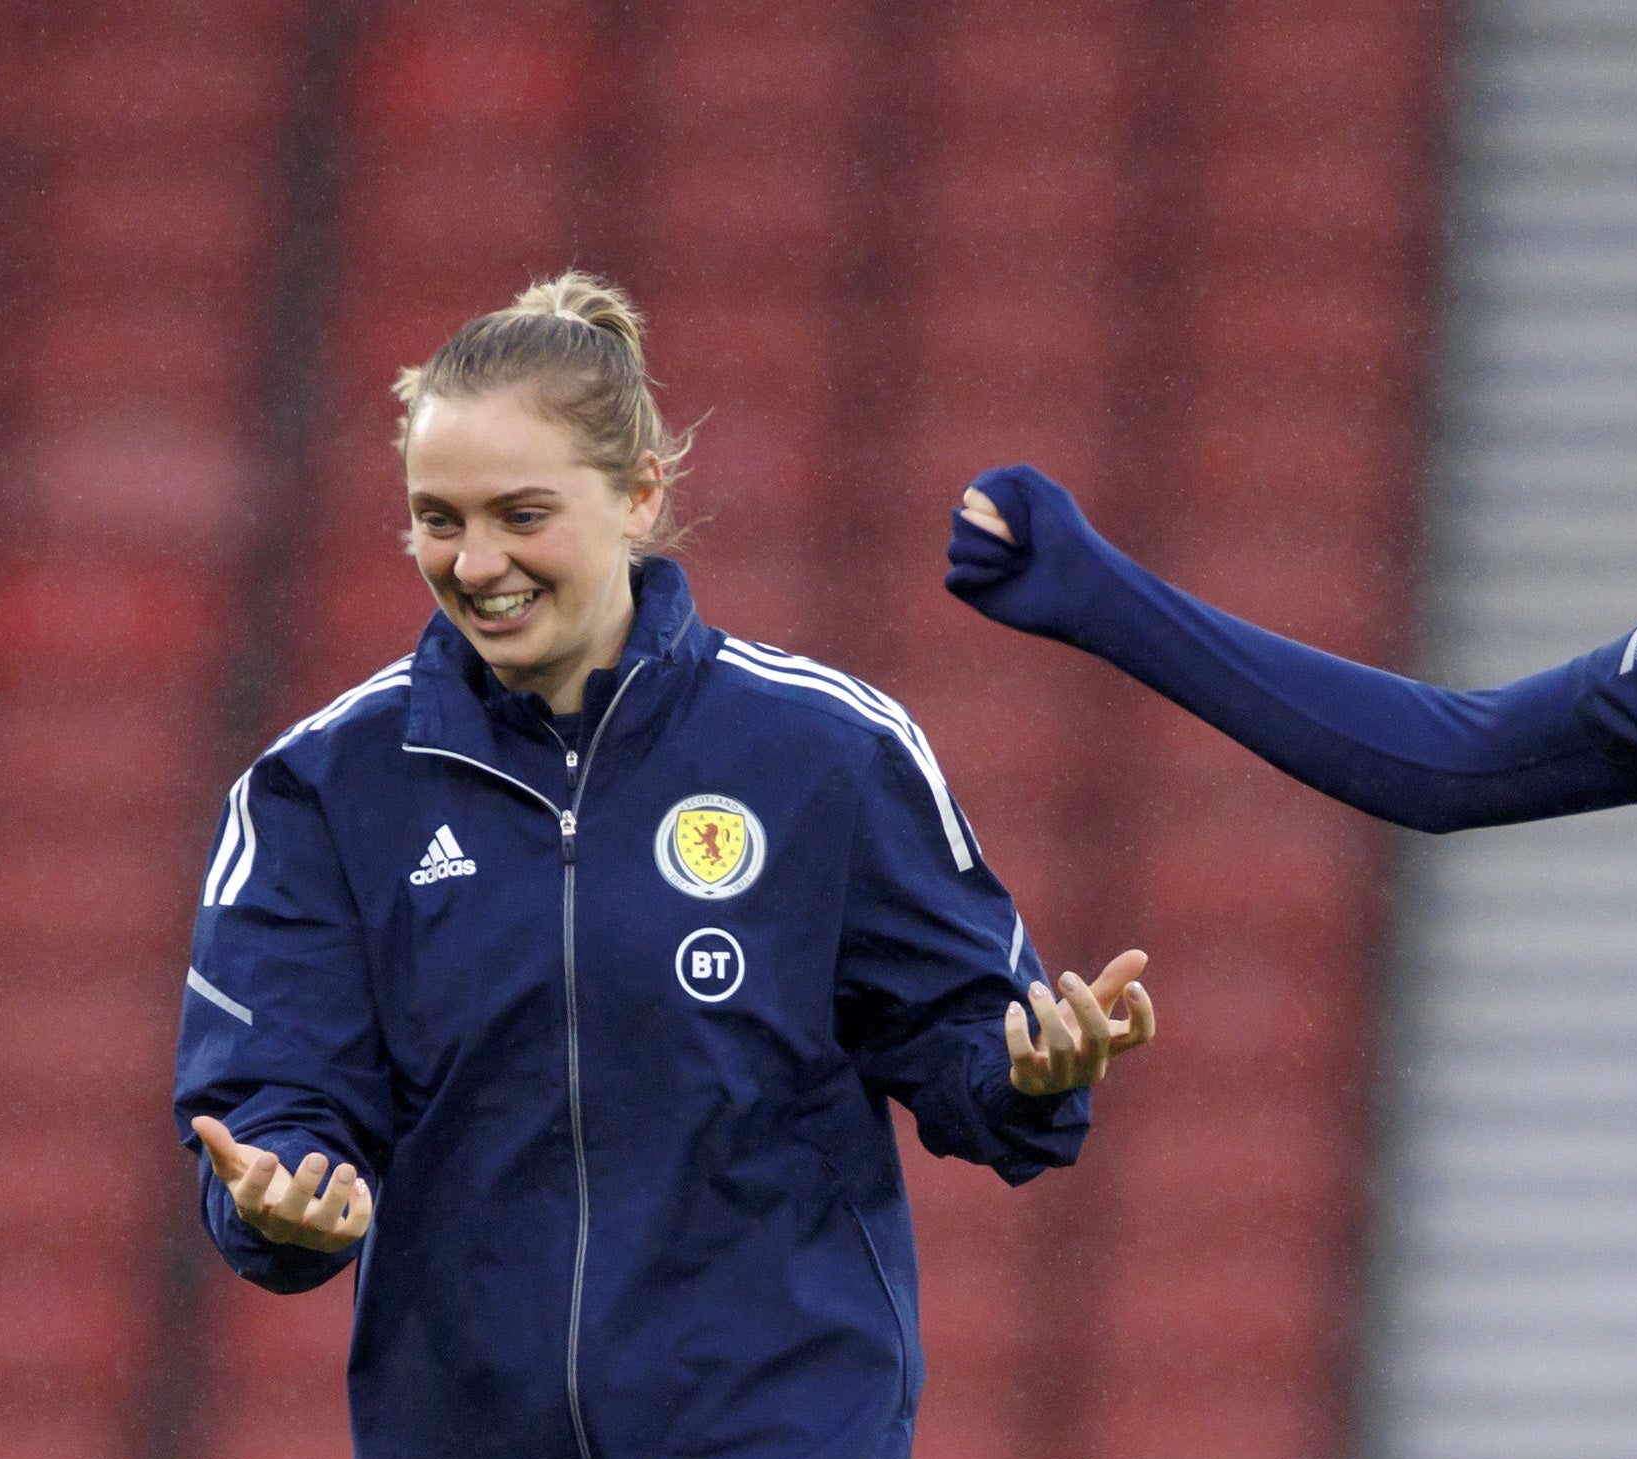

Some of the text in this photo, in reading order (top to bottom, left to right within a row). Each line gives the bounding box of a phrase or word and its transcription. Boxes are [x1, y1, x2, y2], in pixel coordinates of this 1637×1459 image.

[684, 795, 739, 812] SCOTLAND
[409, 859, 477, 886] adidas
[692, 950, 731, 979] BT
